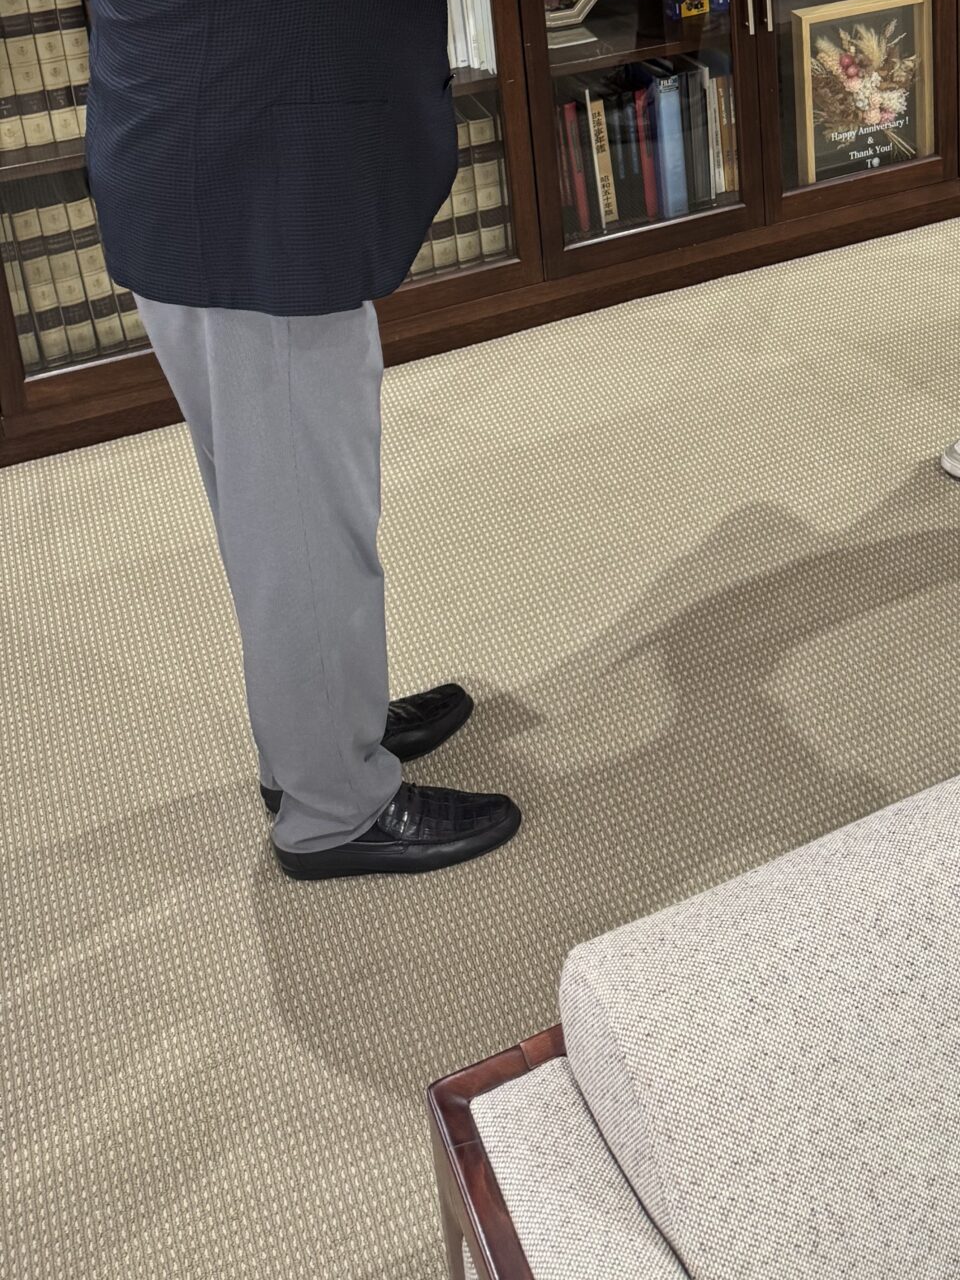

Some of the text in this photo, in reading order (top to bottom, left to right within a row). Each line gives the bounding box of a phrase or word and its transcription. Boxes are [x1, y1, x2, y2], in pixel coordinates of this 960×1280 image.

[831, 129, 857, 141] Happy
[867, 136, 874, 144] &
[849, 142, 893, 160] Thank You!
